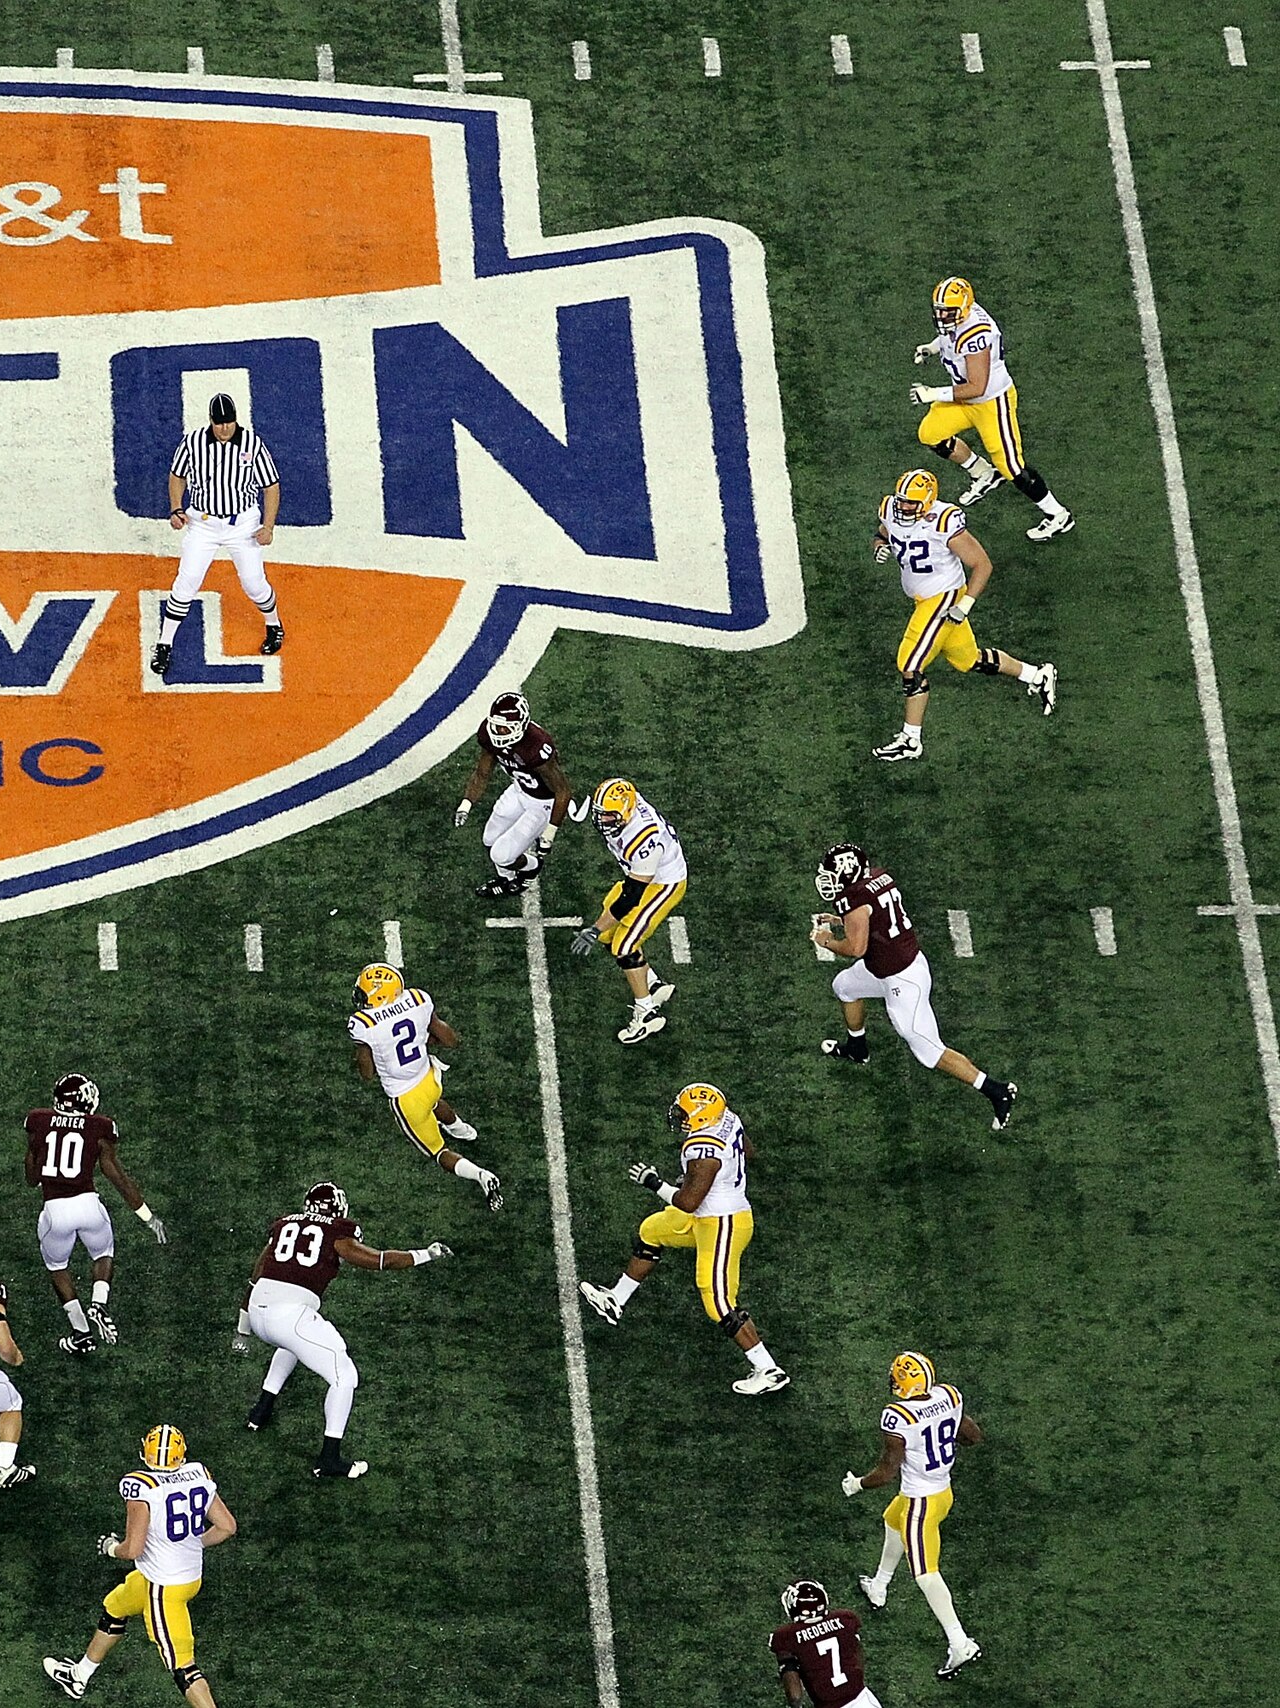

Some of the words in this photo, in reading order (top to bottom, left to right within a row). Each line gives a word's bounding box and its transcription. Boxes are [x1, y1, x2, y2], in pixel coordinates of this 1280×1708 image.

[967, 334, 988, 354] 60
[890, 534, 933, 574] 72
[638, 838, 657, 860] 64
[835, 897, 851, 914] 77
[877, 887, 913, 939] 77
[366, 969, 393, 981] LSU
[374, 998, 415, 1022] RANDLE
[392, 1018, 422, 1067] 2
[689, 1090, 718, 1105] LSU
[49, 1115, 86, 1130] PORTER
[41, 1130, 85, 1179] 10
[693, 1147, 716, 1159] 78
[274, 1222, 324, 1268] 83
[915, 1399, 952, 1420] MURPHY
[882, 1412, 899, 1431] 18
[921, 1417, 957, 1472] 18
[122, 1481, 141, 1499] 68
[165, 1485, 209, 1543] 68
[795, 1617, 845, 1644] FREDERICK
[815, 1636, 848, 1688] 7
